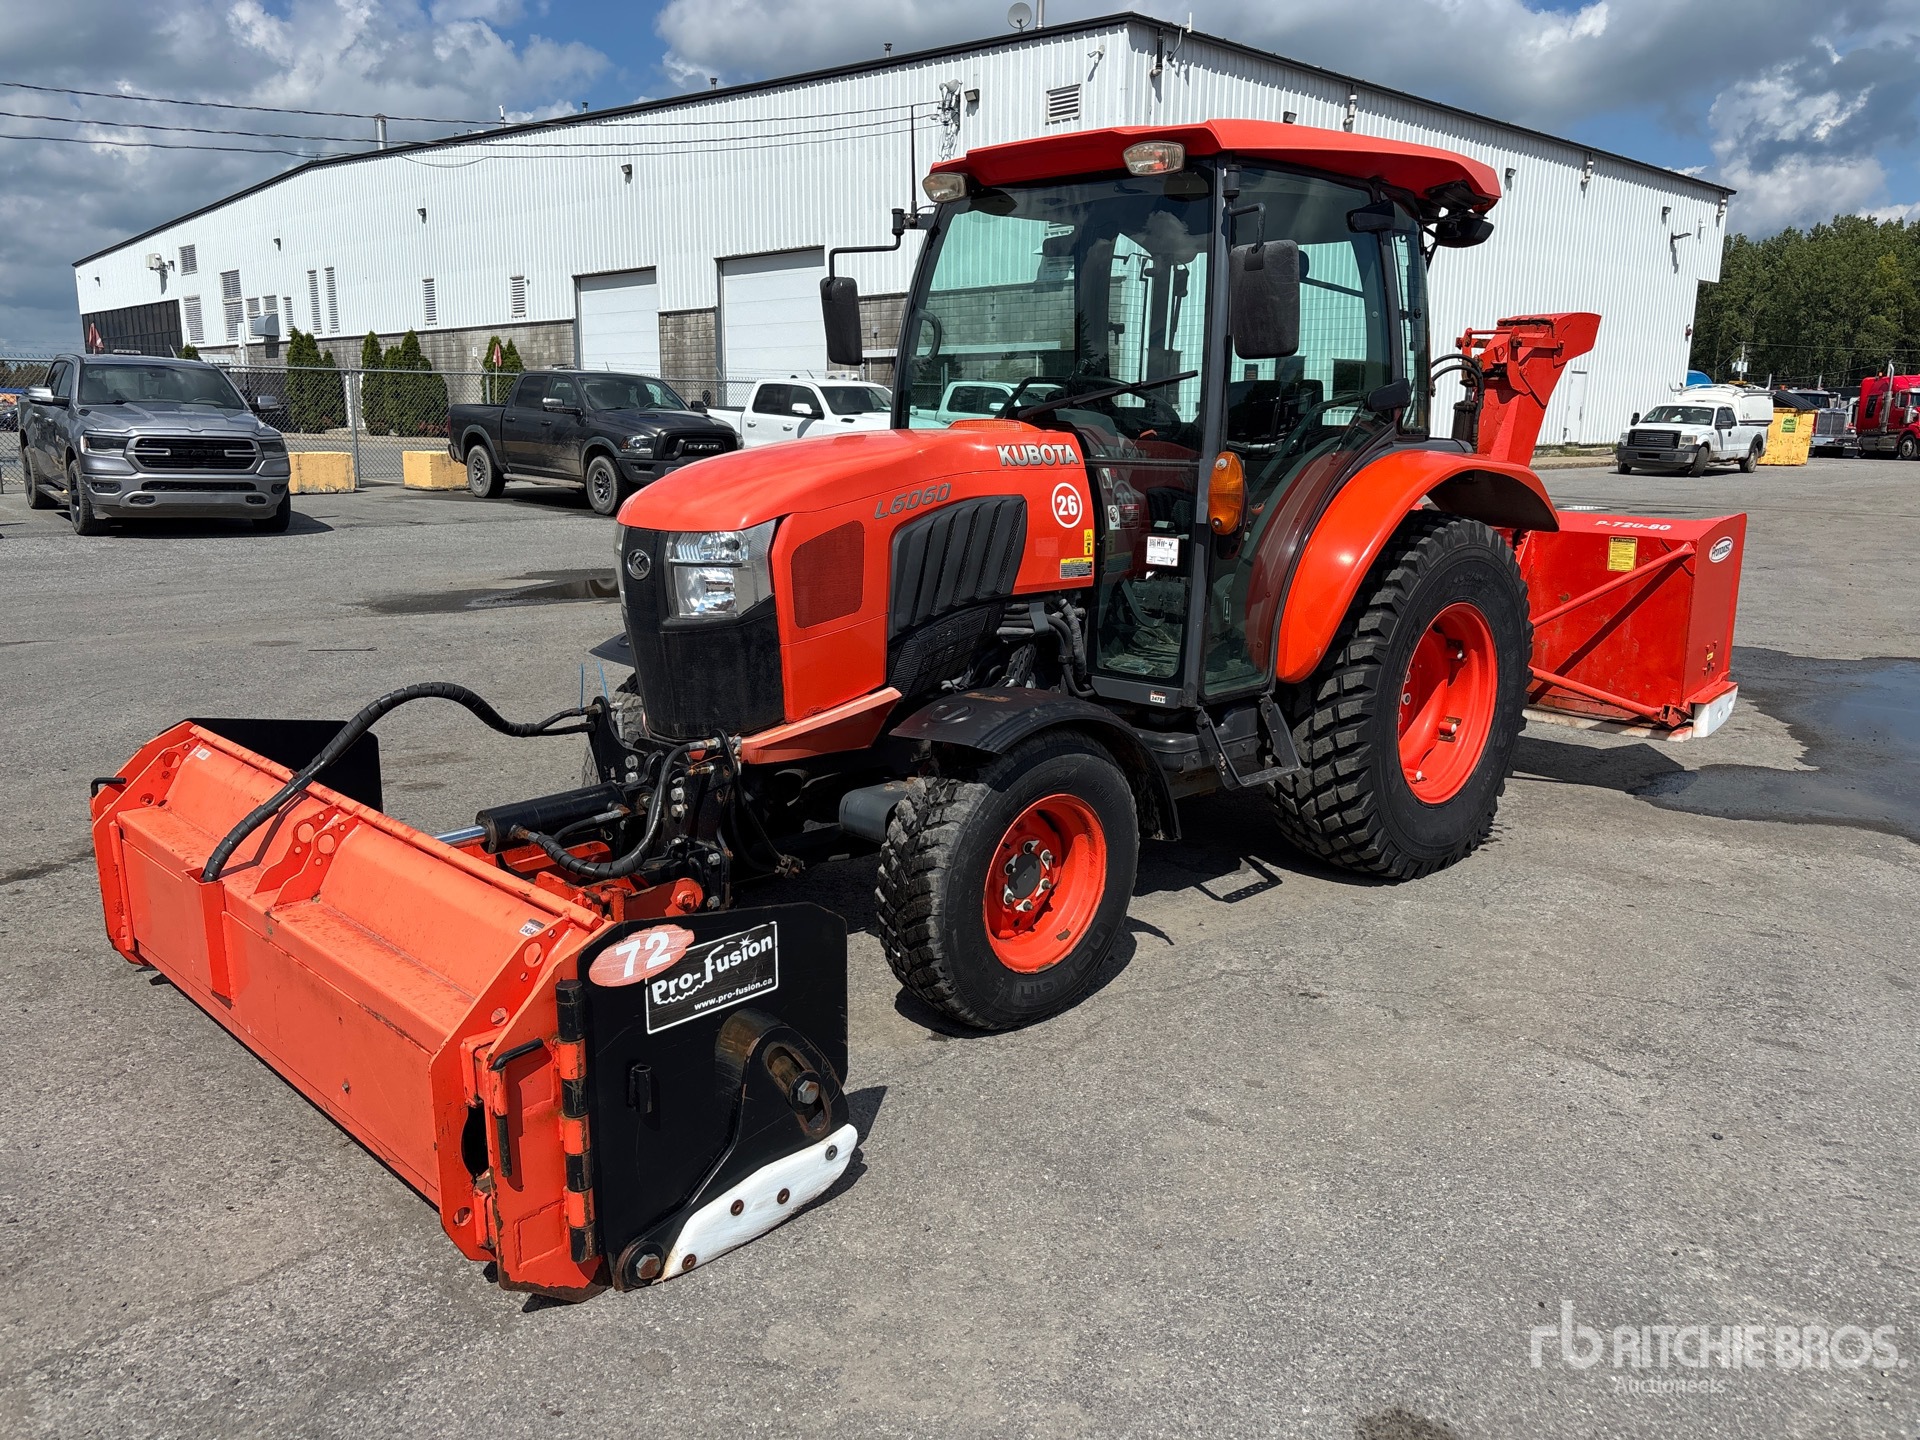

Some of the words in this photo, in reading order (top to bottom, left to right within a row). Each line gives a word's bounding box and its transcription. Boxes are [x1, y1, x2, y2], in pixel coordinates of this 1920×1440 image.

[996, 444, 1080, 466] KUBOTA
[873, 483, 951, 519] L6060
[1057, 495, 1078, 516] 26
[1593, 520, 1672, 530] P-720-80
[615, 931, 671, 978] 72
[694, 977, 772, 1010] www.pro-fusion.ca
